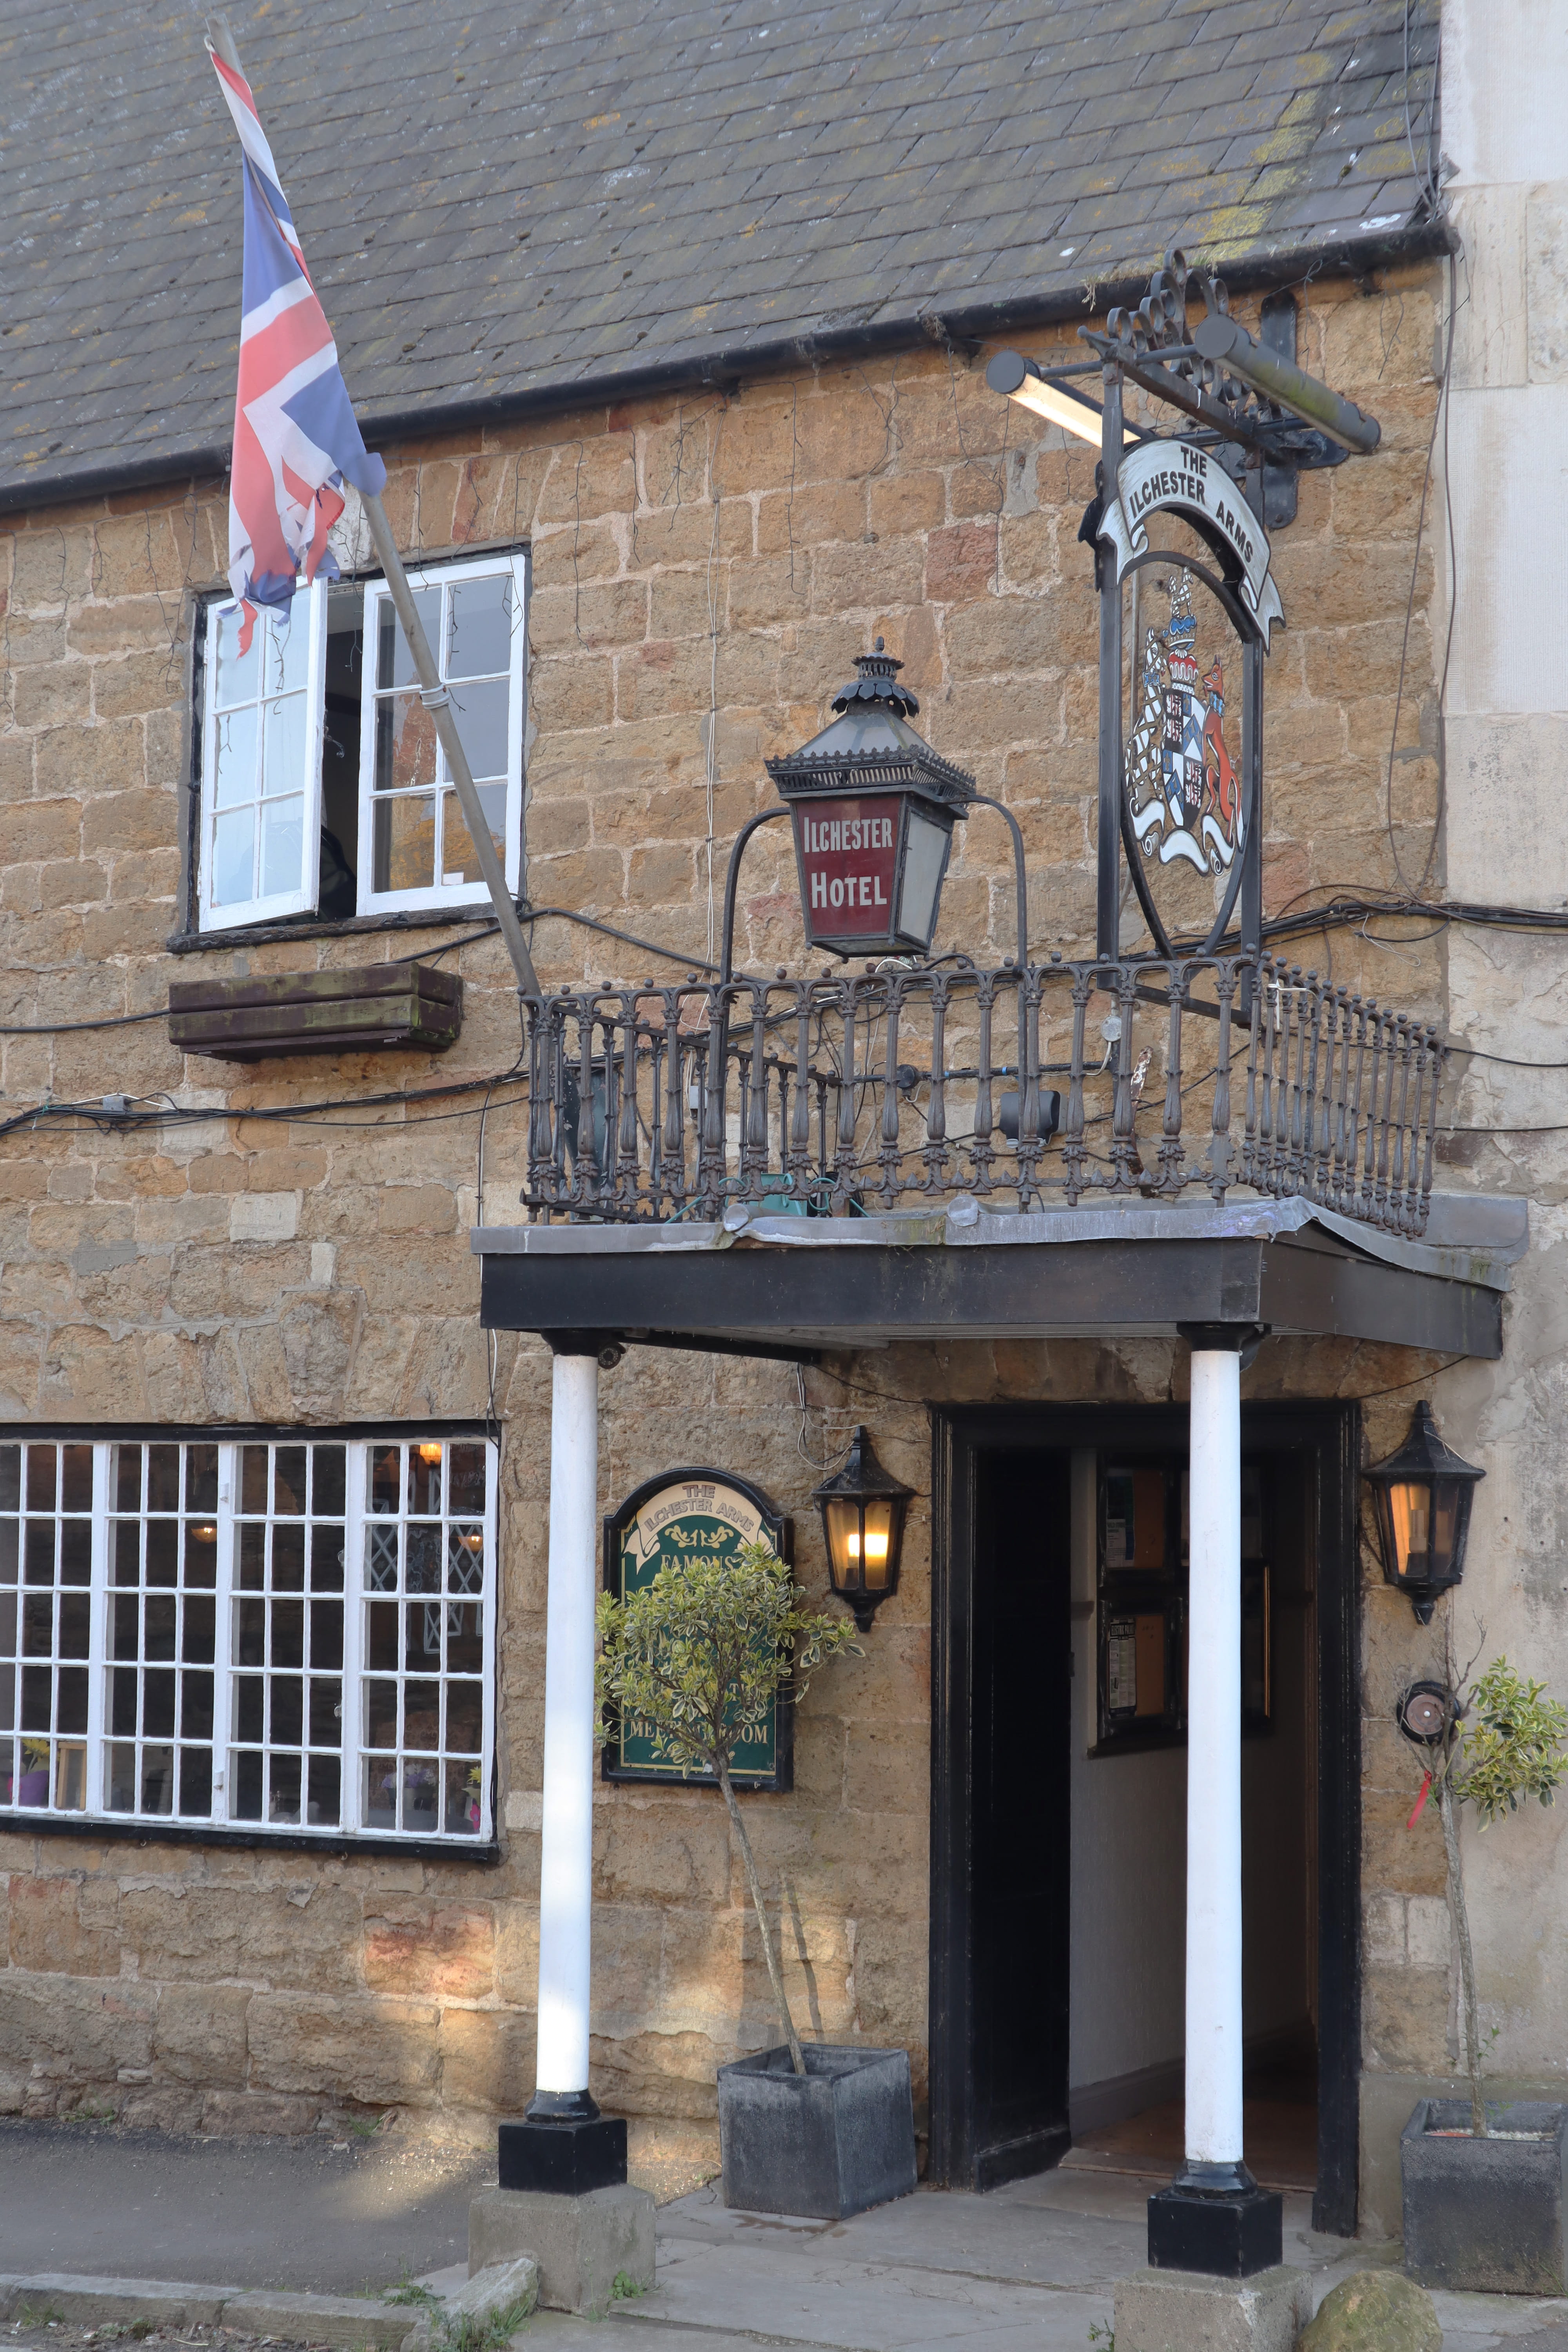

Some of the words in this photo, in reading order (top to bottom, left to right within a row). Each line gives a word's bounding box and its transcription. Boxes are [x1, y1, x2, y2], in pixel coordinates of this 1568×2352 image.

[1181, 446, 1207, 478] THE
[1129, 471, 1206, 519] ILCHESTER
[1216, 500, 1253, 563] ARMS
[804, 817, 893, 853] ILCHESTER
[811, 872, 887, 909] HOTEL
[682, 1485, 715, 1498] THE
[644, 1498, 713, 1532] ILCHESTER
[716, 1503, 754, 1532] ARMS
